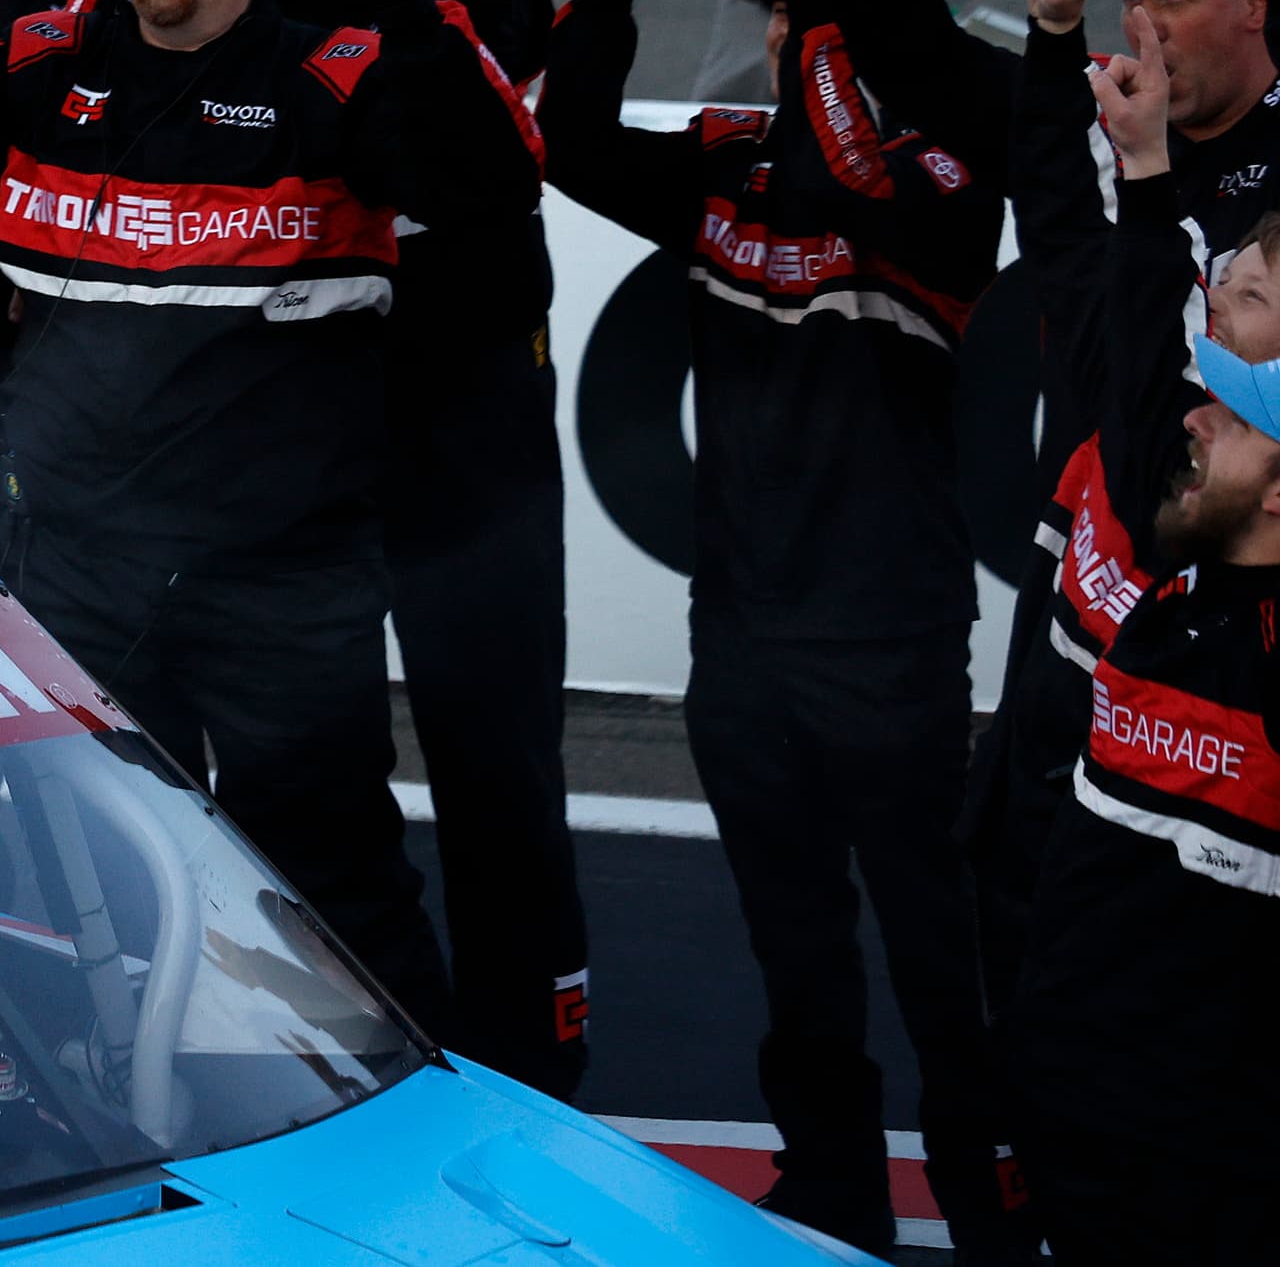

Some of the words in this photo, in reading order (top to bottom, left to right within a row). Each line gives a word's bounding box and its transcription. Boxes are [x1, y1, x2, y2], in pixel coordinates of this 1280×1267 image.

[200, 99, 277, 123] TOYOTA
[176, 205, 322, 246] GARAGE
[1110, 706, 1246, 782] GARAGE
